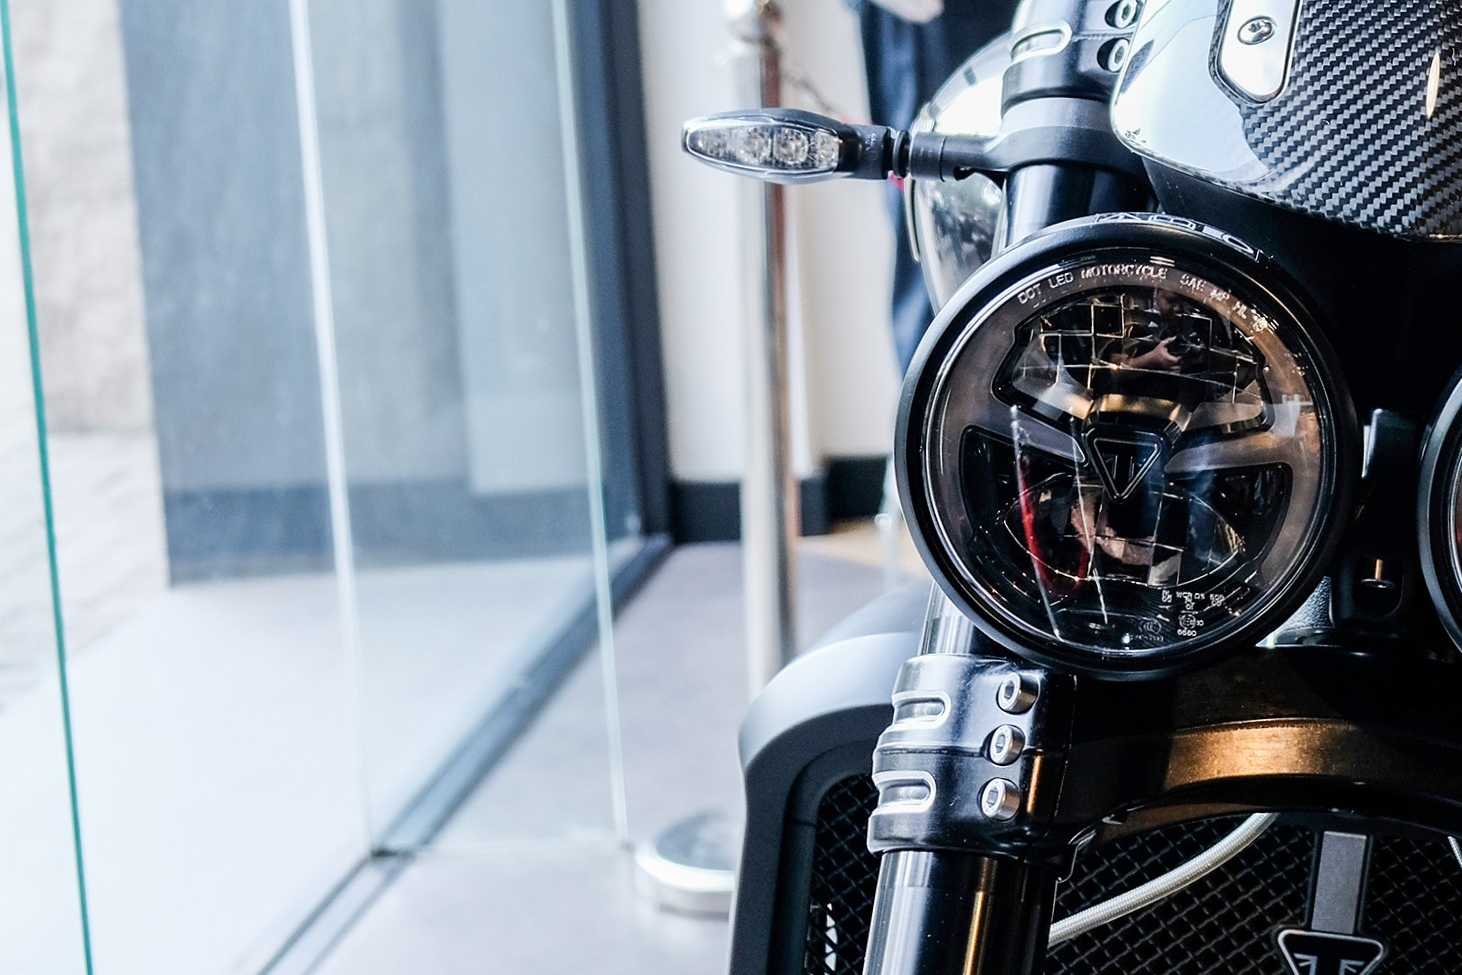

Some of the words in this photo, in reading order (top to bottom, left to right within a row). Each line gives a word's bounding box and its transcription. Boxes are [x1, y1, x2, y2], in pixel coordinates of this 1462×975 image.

[1017, 283, 1041, 304] DOT
[1048, 272, 1074, 289] LED
[1081, 264, 1168, 280] MOTORCYCLE
